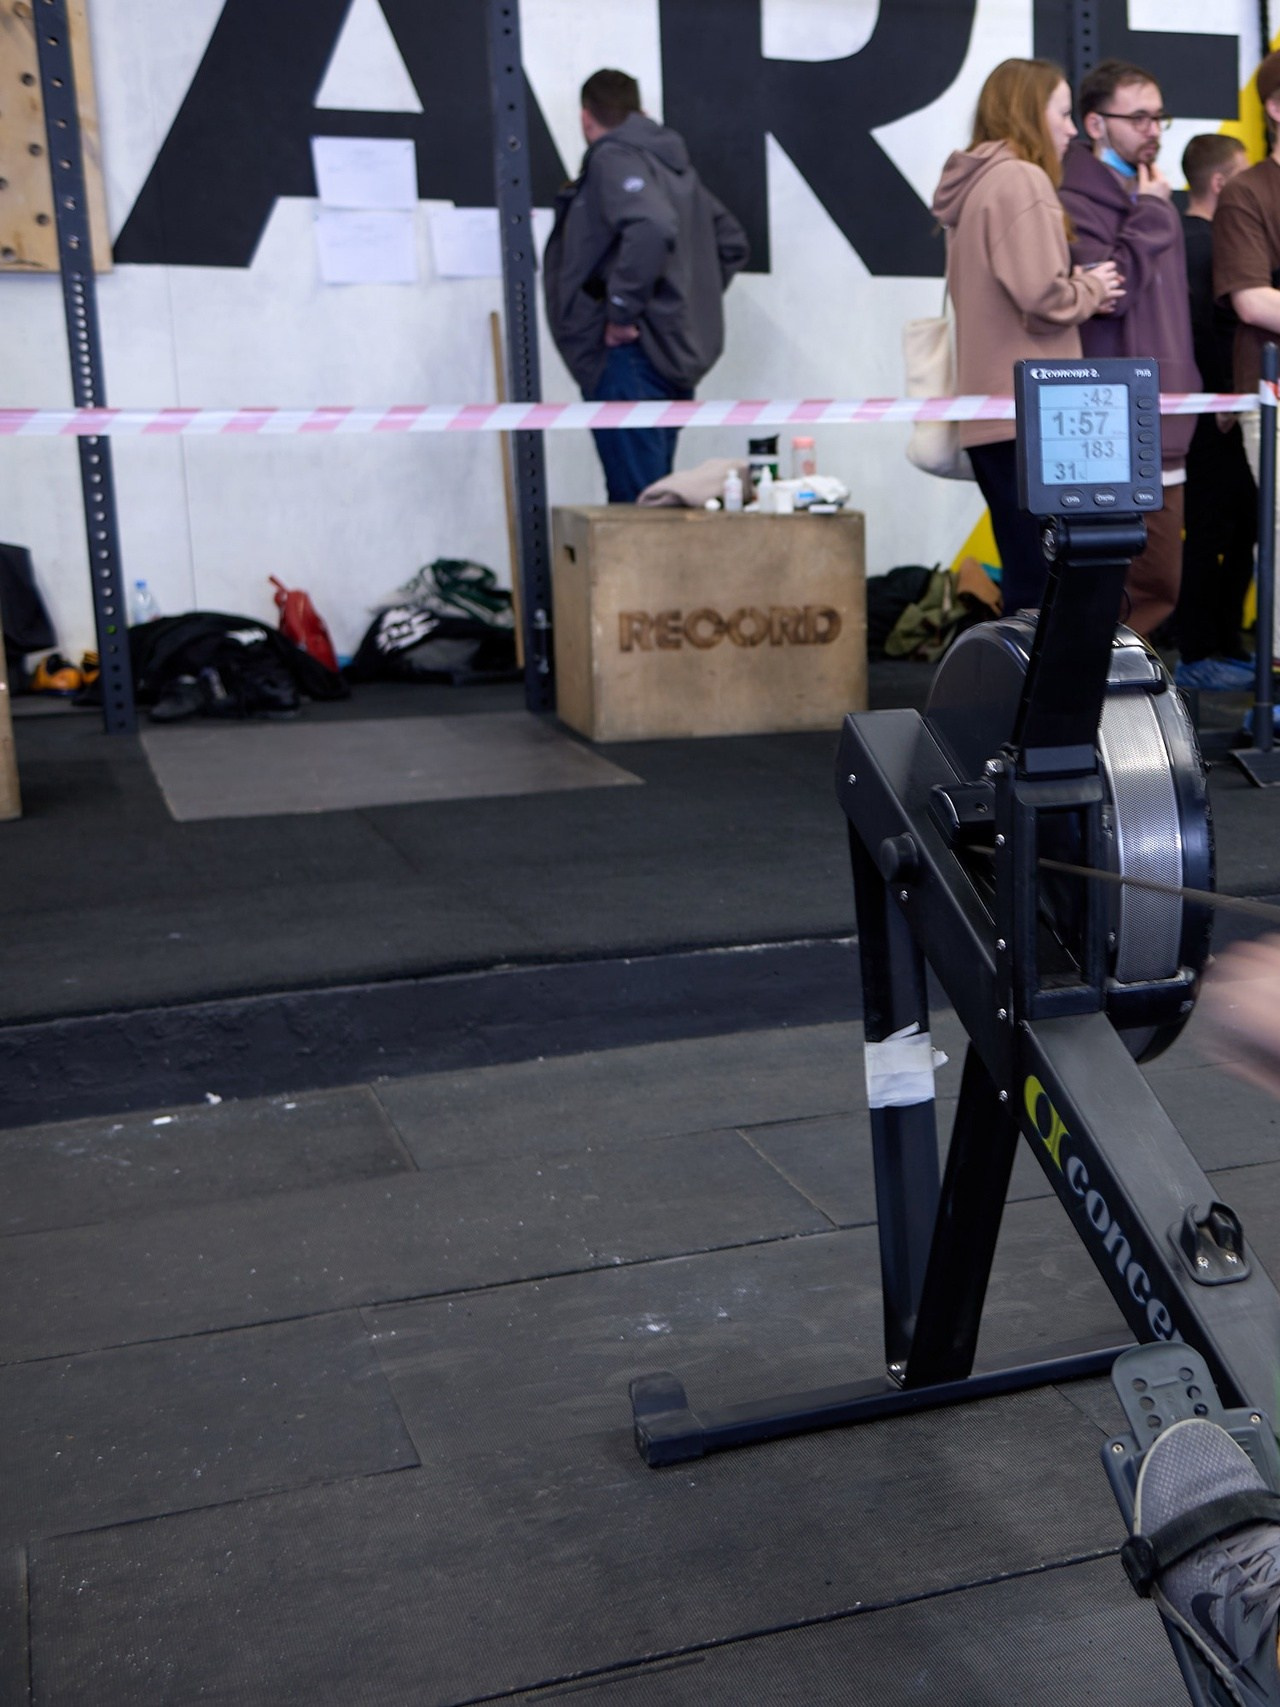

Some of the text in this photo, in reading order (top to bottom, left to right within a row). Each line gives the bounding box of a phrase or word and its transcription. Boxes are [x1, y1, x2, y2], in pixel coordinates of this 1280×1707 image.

[1053, 411, 1109, 436] 1:57
[1082, 441, 1115, 459] 183
[1055, 462, 1077, 481] 31
[618, 604, 842, 654] RECORD
[1066, 1156, 1184, 1342] conce
